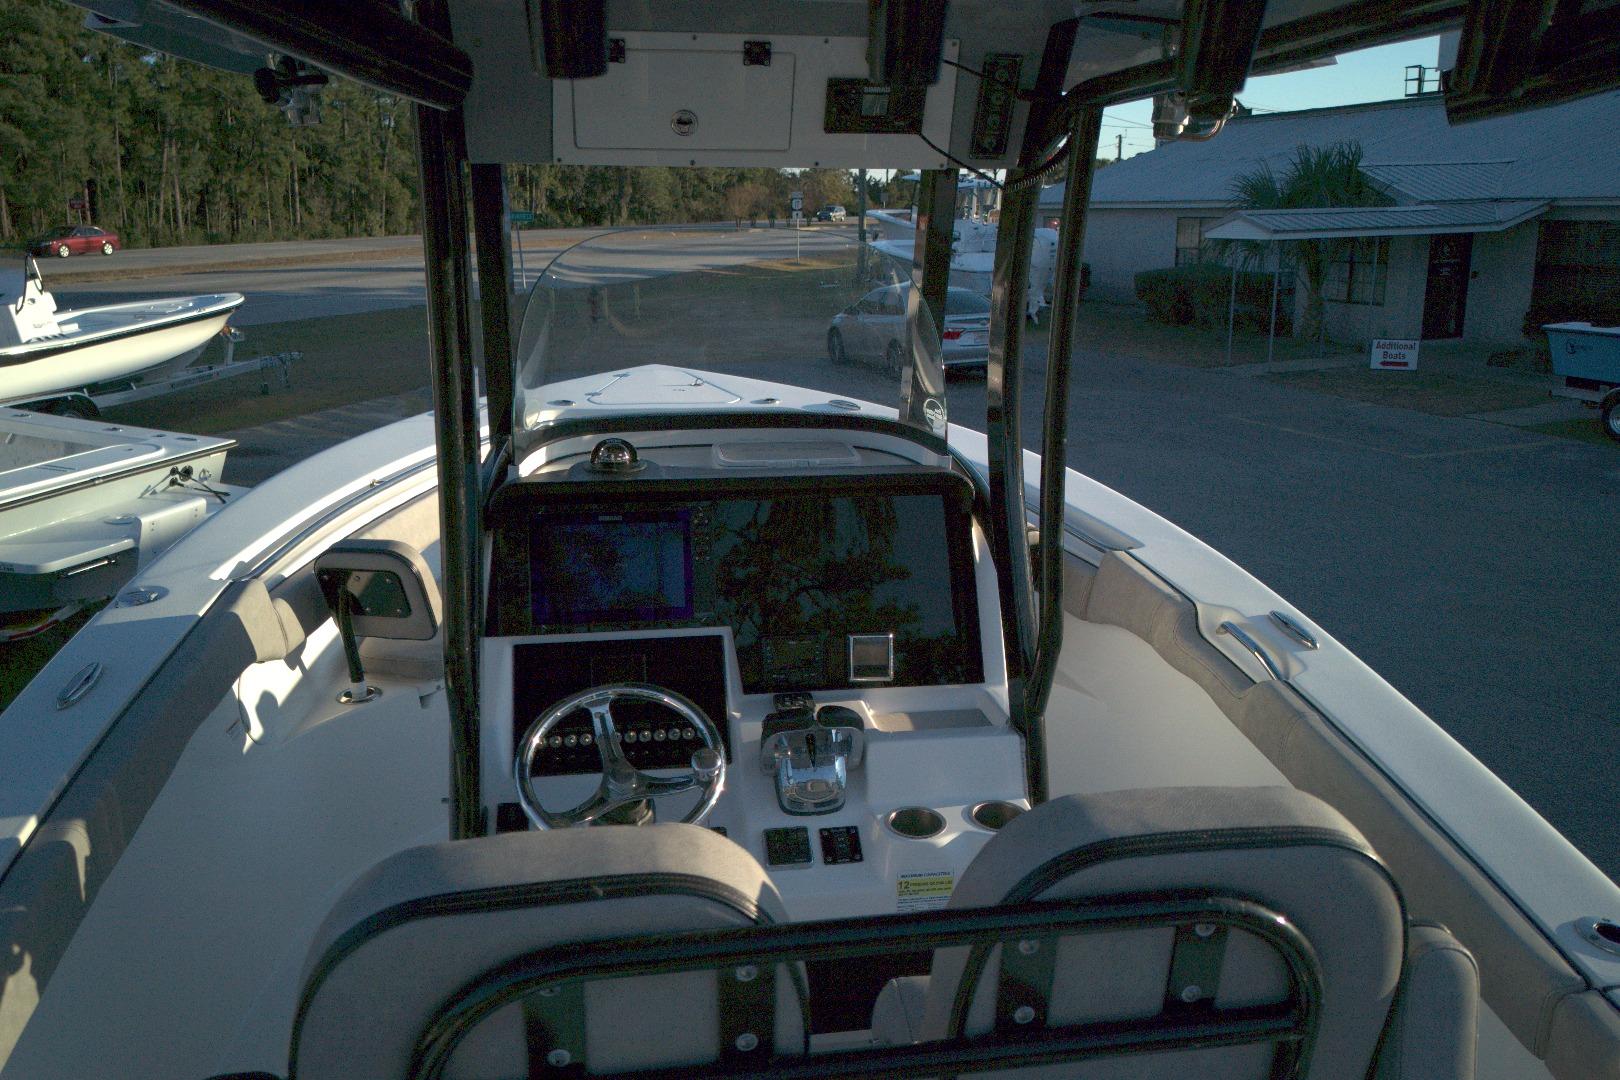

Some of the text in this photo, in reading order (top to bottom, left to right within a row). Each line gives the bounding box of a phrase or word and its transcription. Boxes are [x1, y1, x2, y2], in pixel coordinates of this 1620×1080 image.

[1376, 341, 1416, 351] Additional
[1383, 351, 1406, 360] Boats
[898, 880, 910, 890] 12
